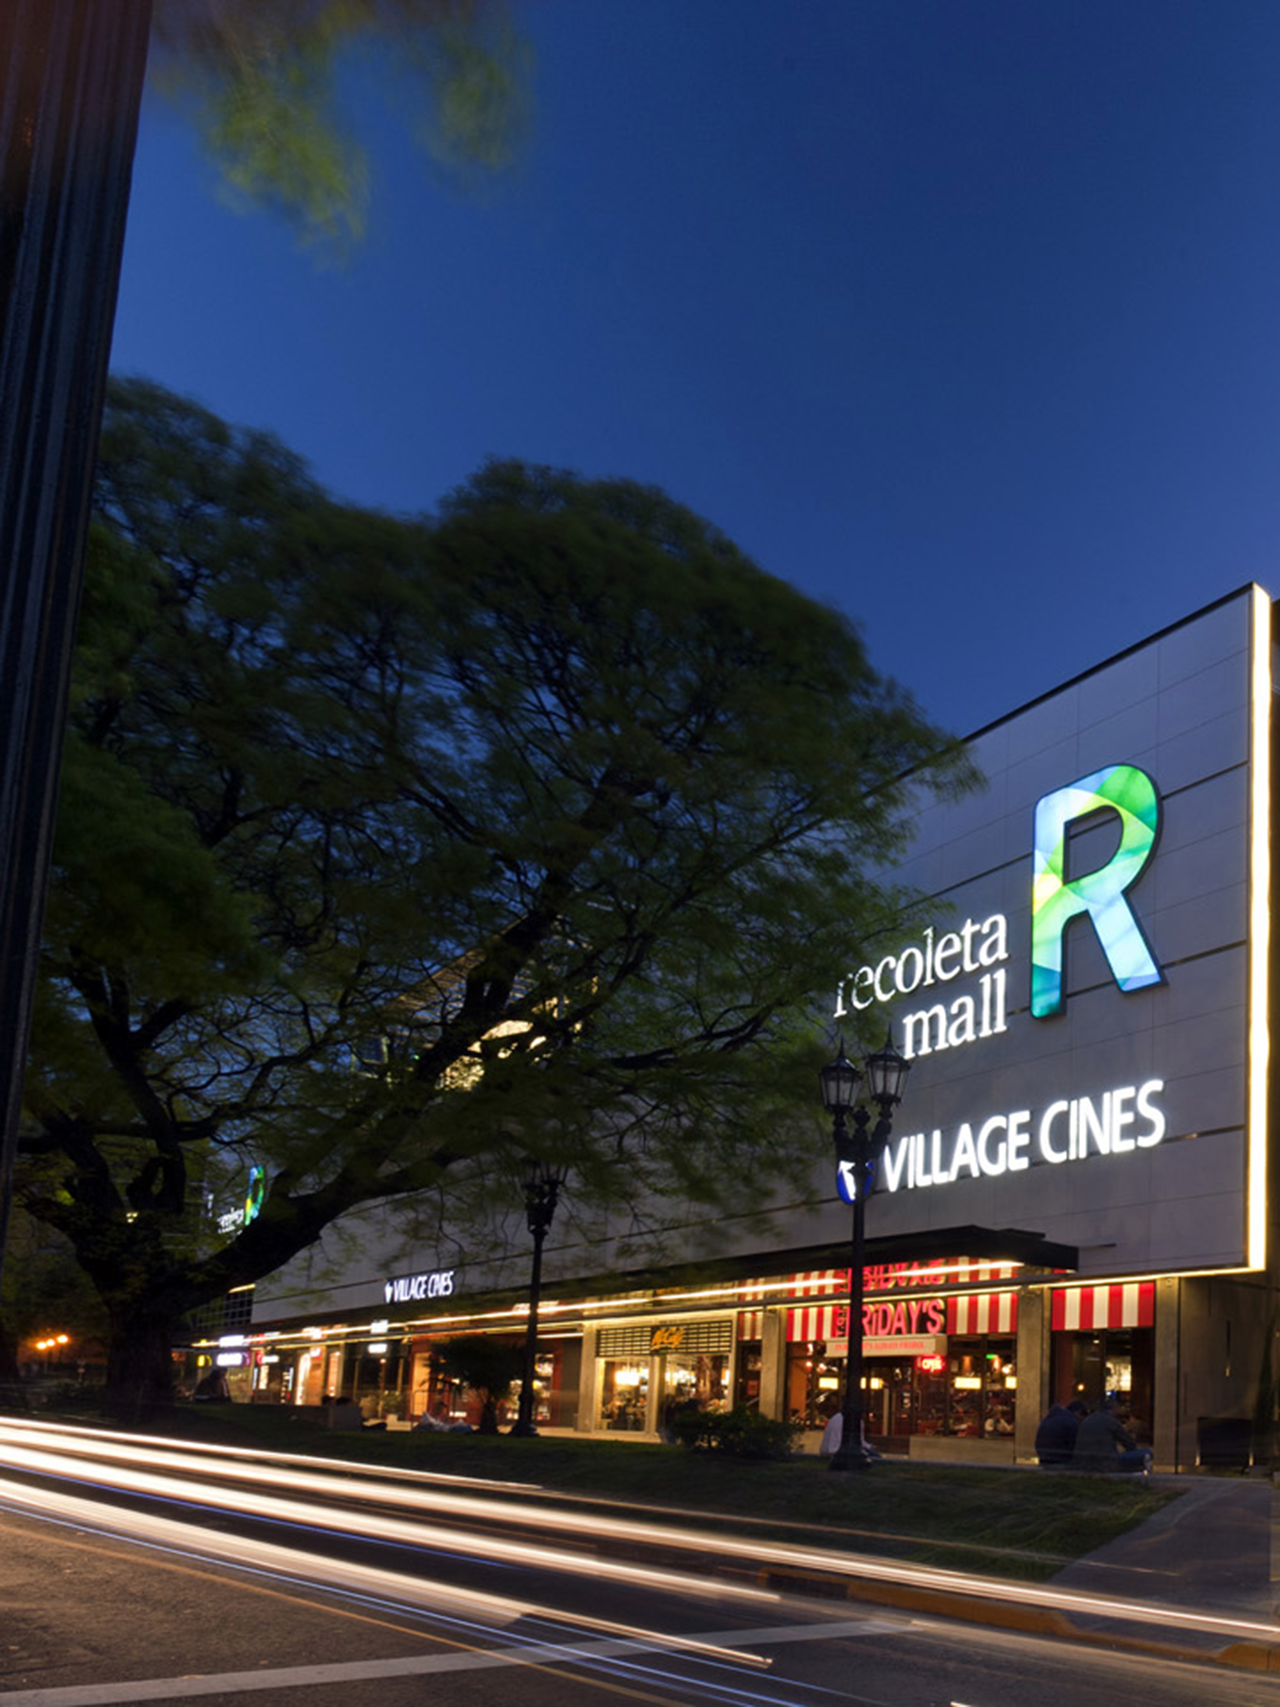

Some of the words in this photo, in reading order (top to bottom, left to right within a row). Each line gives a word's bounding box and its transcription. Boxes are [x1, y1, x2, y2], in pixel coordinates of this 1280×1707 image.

[1031, 763, 1164, 1018] R
[833, 913, 1009, 1018] recoleta
[902, 968, 1007, 1060] mall
[884, 1109, 1031, 1192] VILLAGE
[1038, 1079, 1166, 1164] CINES
[393, 1275, 428, 1303] VILLAGE
[427, 1270, 454, 1299] CINES
